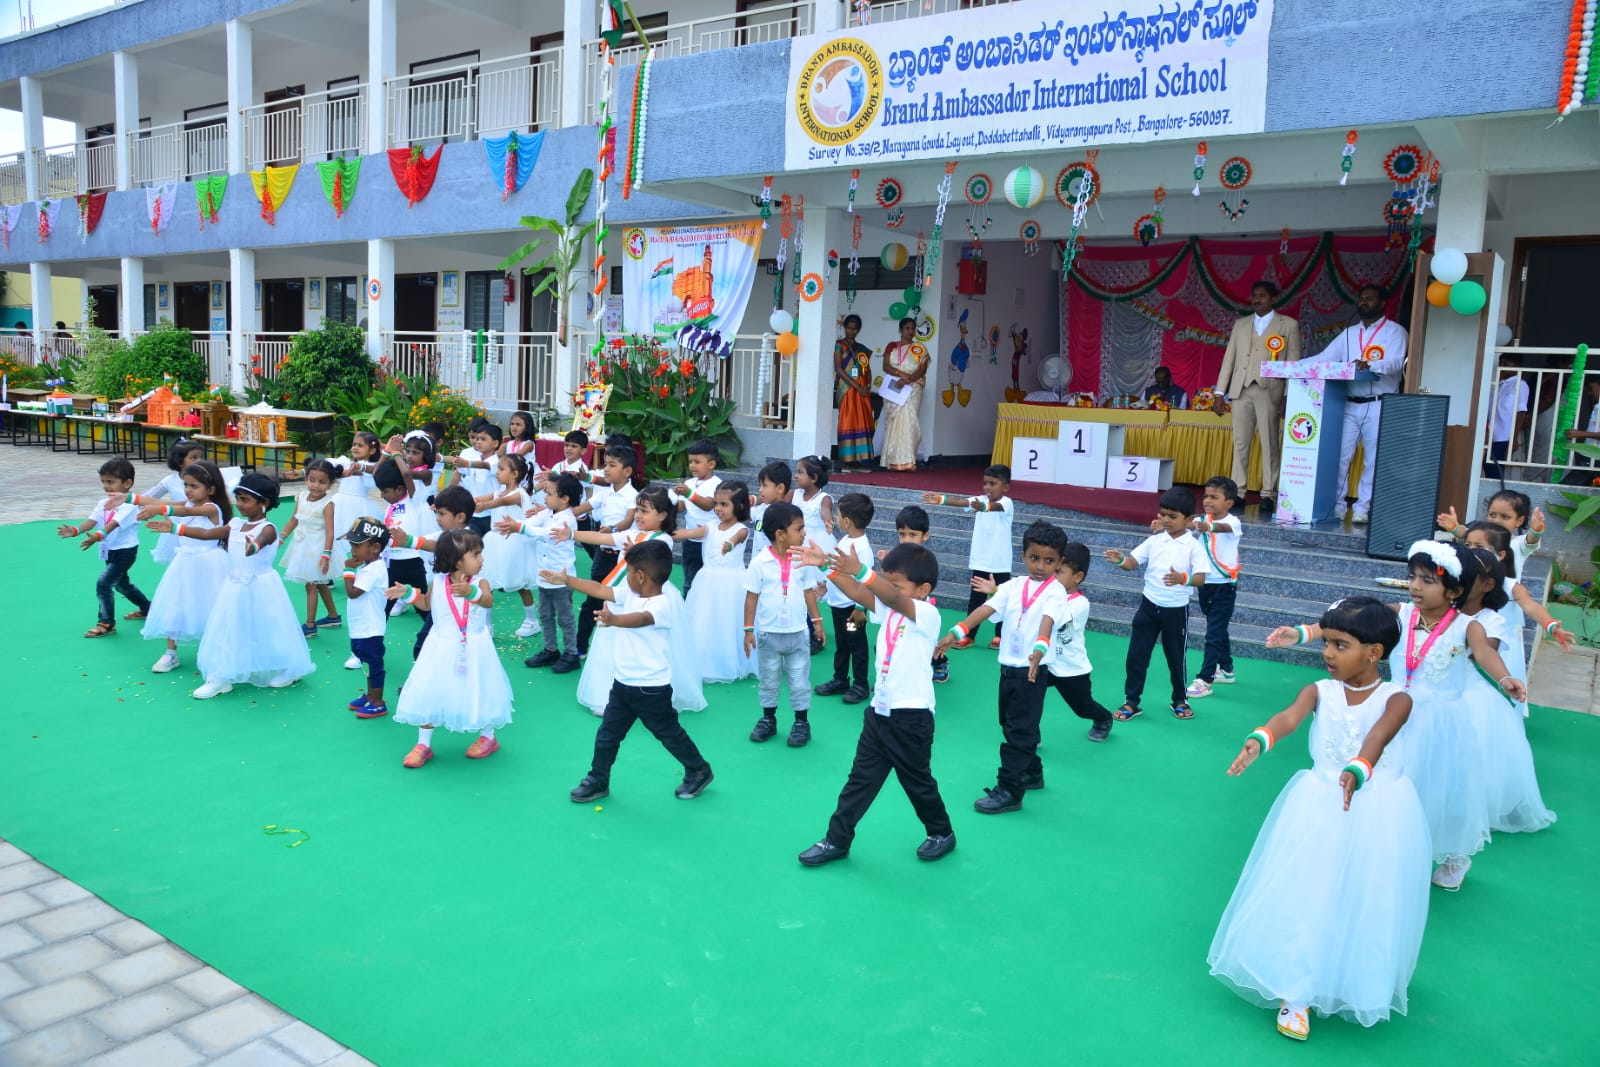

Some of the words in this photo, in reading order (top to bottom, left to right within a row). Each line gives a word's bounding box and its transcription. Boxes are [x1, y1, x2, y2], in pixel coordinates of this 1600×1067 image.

[826, 42, 879, 78] AMBASSADOR
[881, 93, 929, 127] Brand
[931, 82, 1031, 121] Ambassador
[1032, 66, 1148, 111] International
[1155, 57, 1228, 98] School
[800, 102, 853, 141] INTERNATIONAL
[854, 92, 879, 132] SCHOOL
[808, 146, 841, 164] Survey
[921, 132, 945, 151] Gowda
[1047, 122, 1113, 144] Vidyaranyapura
[1073, 429, 1086, 454] 1
[1028, 449, 1039, 470] 2
[1125, 461, 1140, 482] 3
[363, 522, 385, 538] BOY
